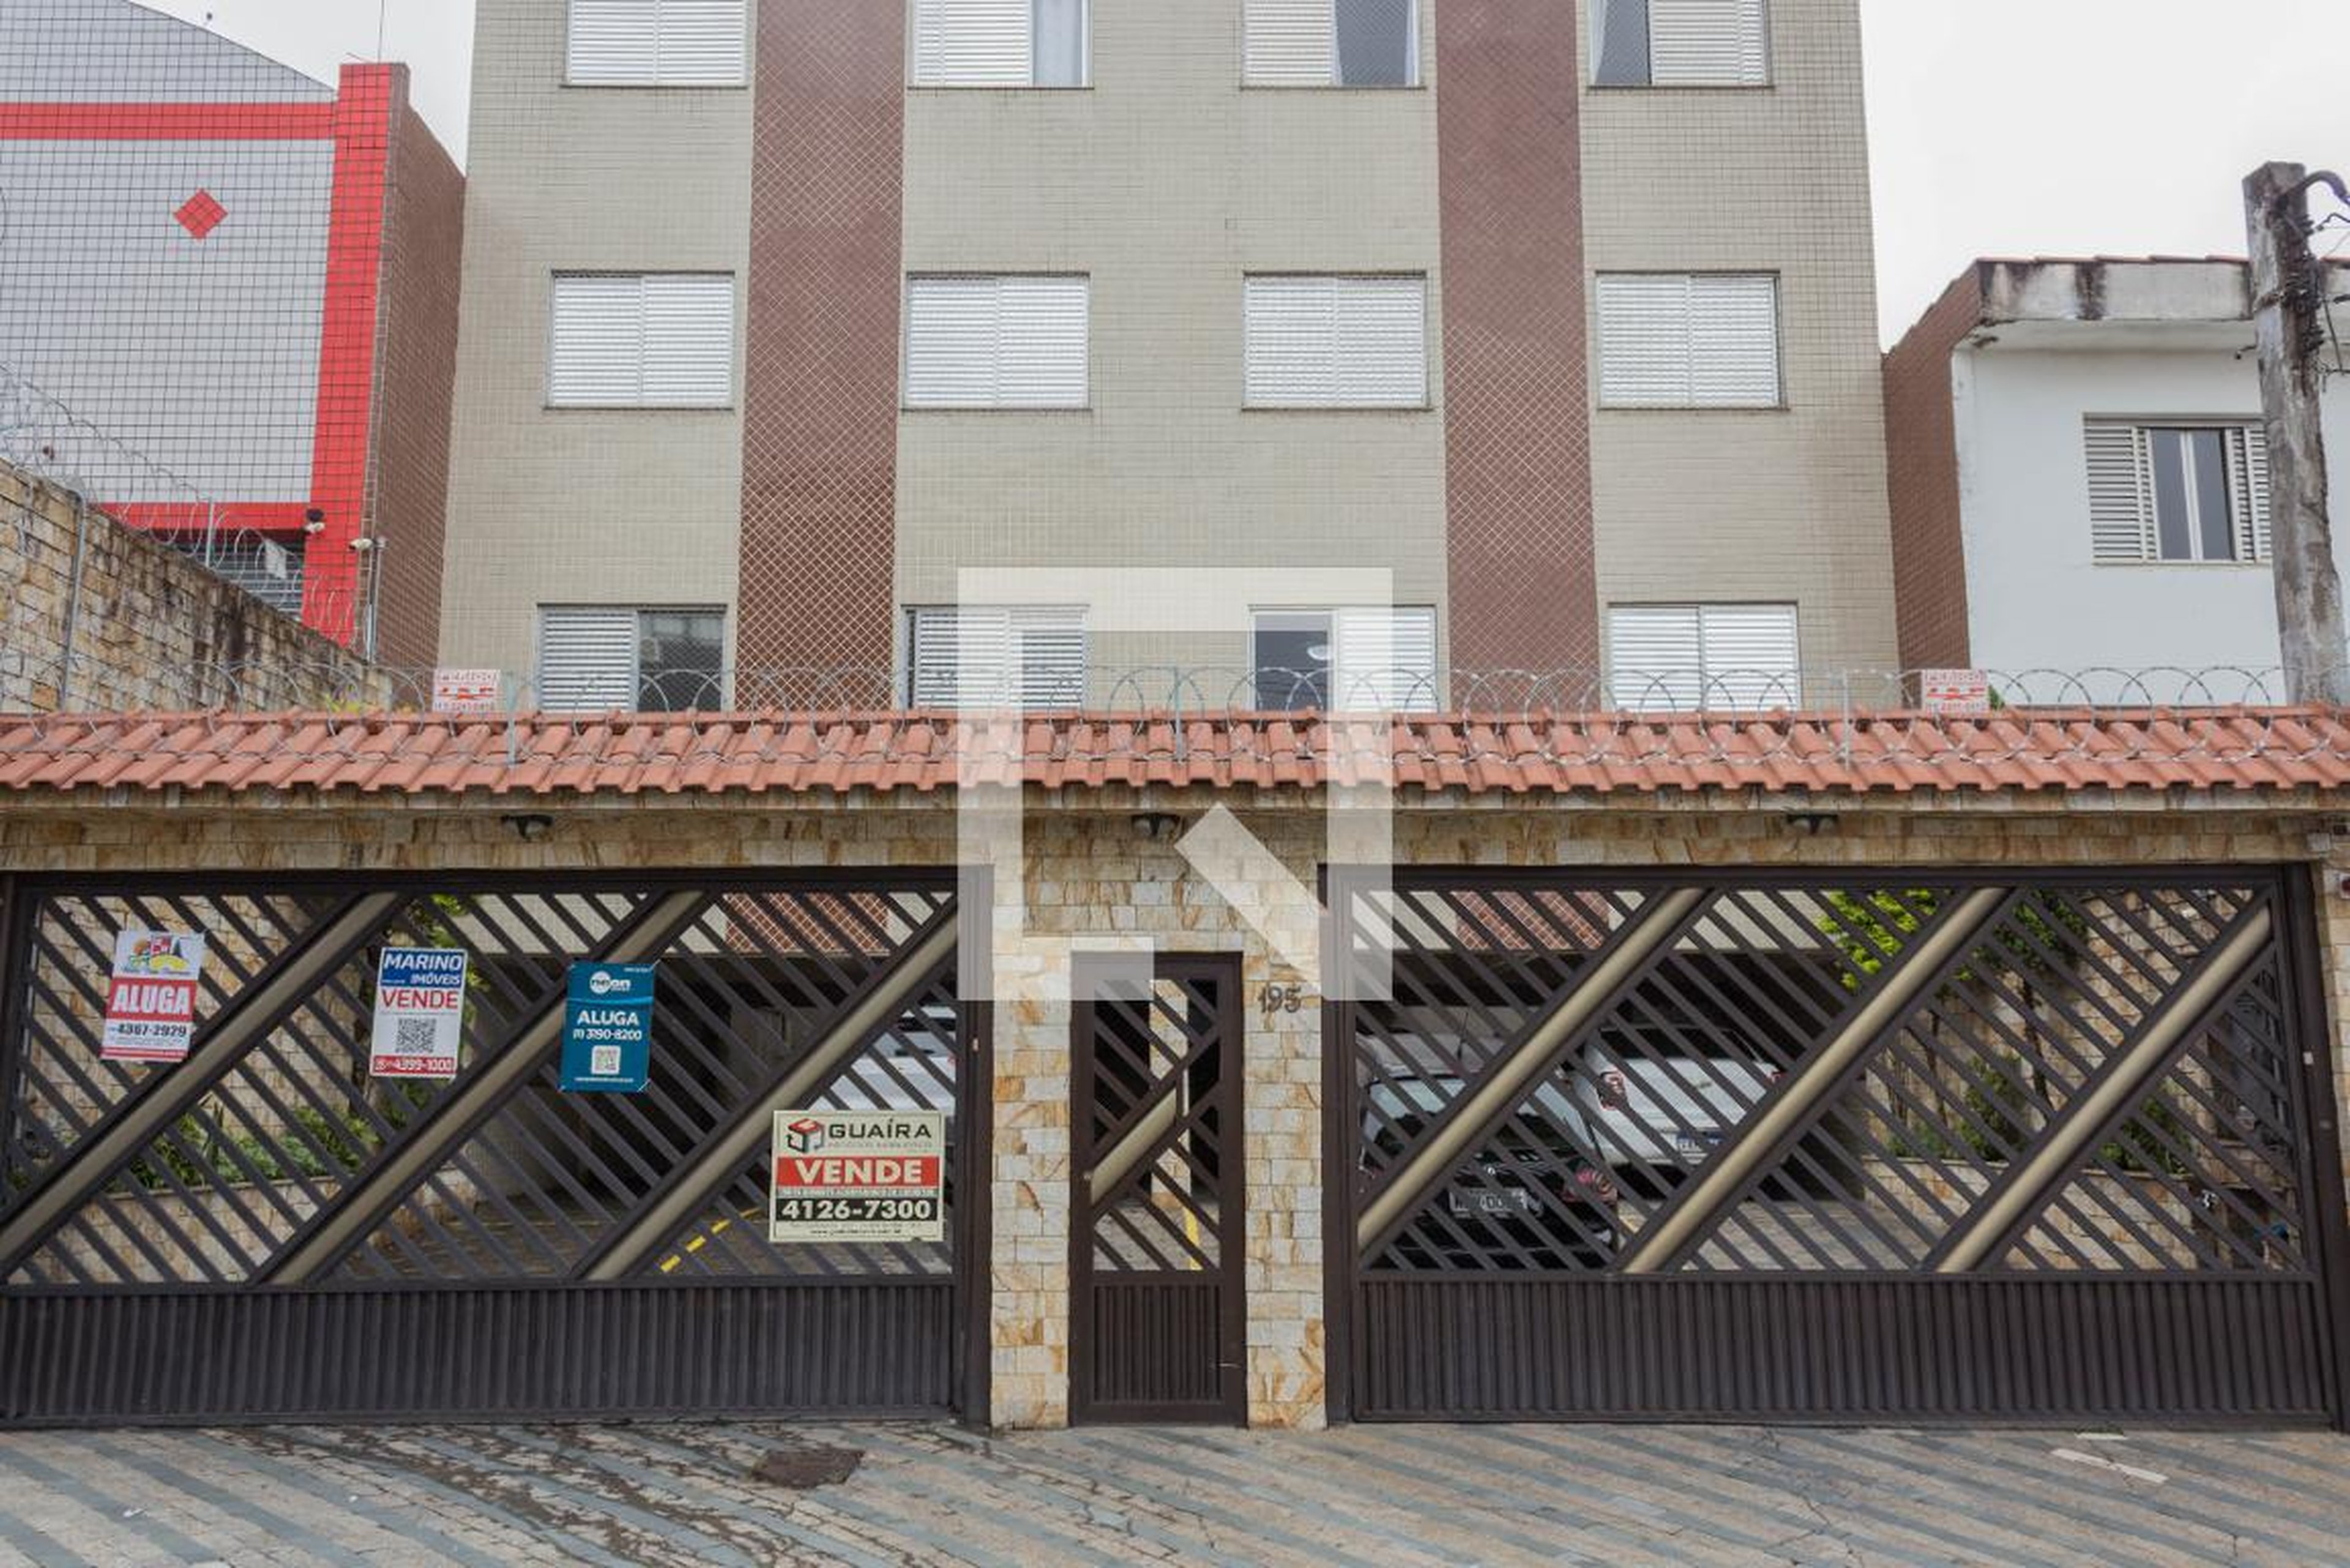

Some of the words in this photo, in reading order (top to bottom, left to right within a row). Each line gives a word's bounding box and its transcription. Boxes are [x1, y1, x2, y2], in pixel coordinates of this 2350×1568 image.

[384, 953, 463, 971] MARINO
[111, 984, 190, 1015] ALUGA
[381, 988, 458, 1009] VENDE
[1258, 986, 1302, 1014] 195
[577, 1010, 640, 1026] ALUGA
[829, 1118, 932, 1138] GUAÍRA
[795, 1160, 922, 1184] VENDE
[781, 1200, 931, 1219] 4126-7300
